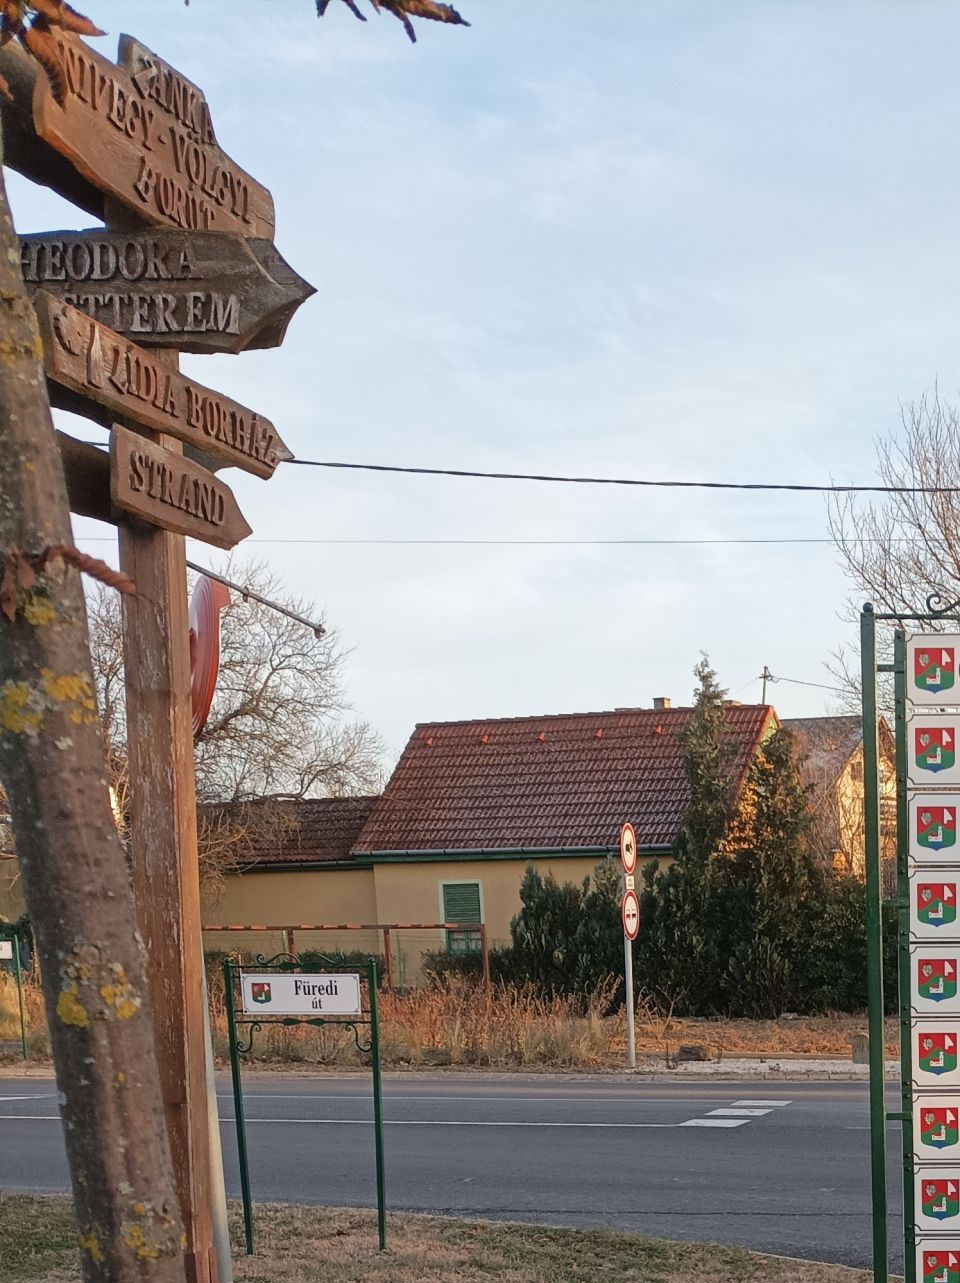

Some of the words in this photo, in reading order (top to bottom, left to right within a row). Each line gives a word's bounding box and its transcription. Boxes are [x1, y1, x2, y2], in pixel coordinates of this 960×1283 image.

[21, 240, 204, 282] HEODORA
[109, 344, 179, 418] LÍDIA
[185, 385, 277, 469] BORHÁZ
[130, 450, 226, 526] STRAND
[293, 979, 339, 996] Füredi
[311, 997, 323, 1010] út
